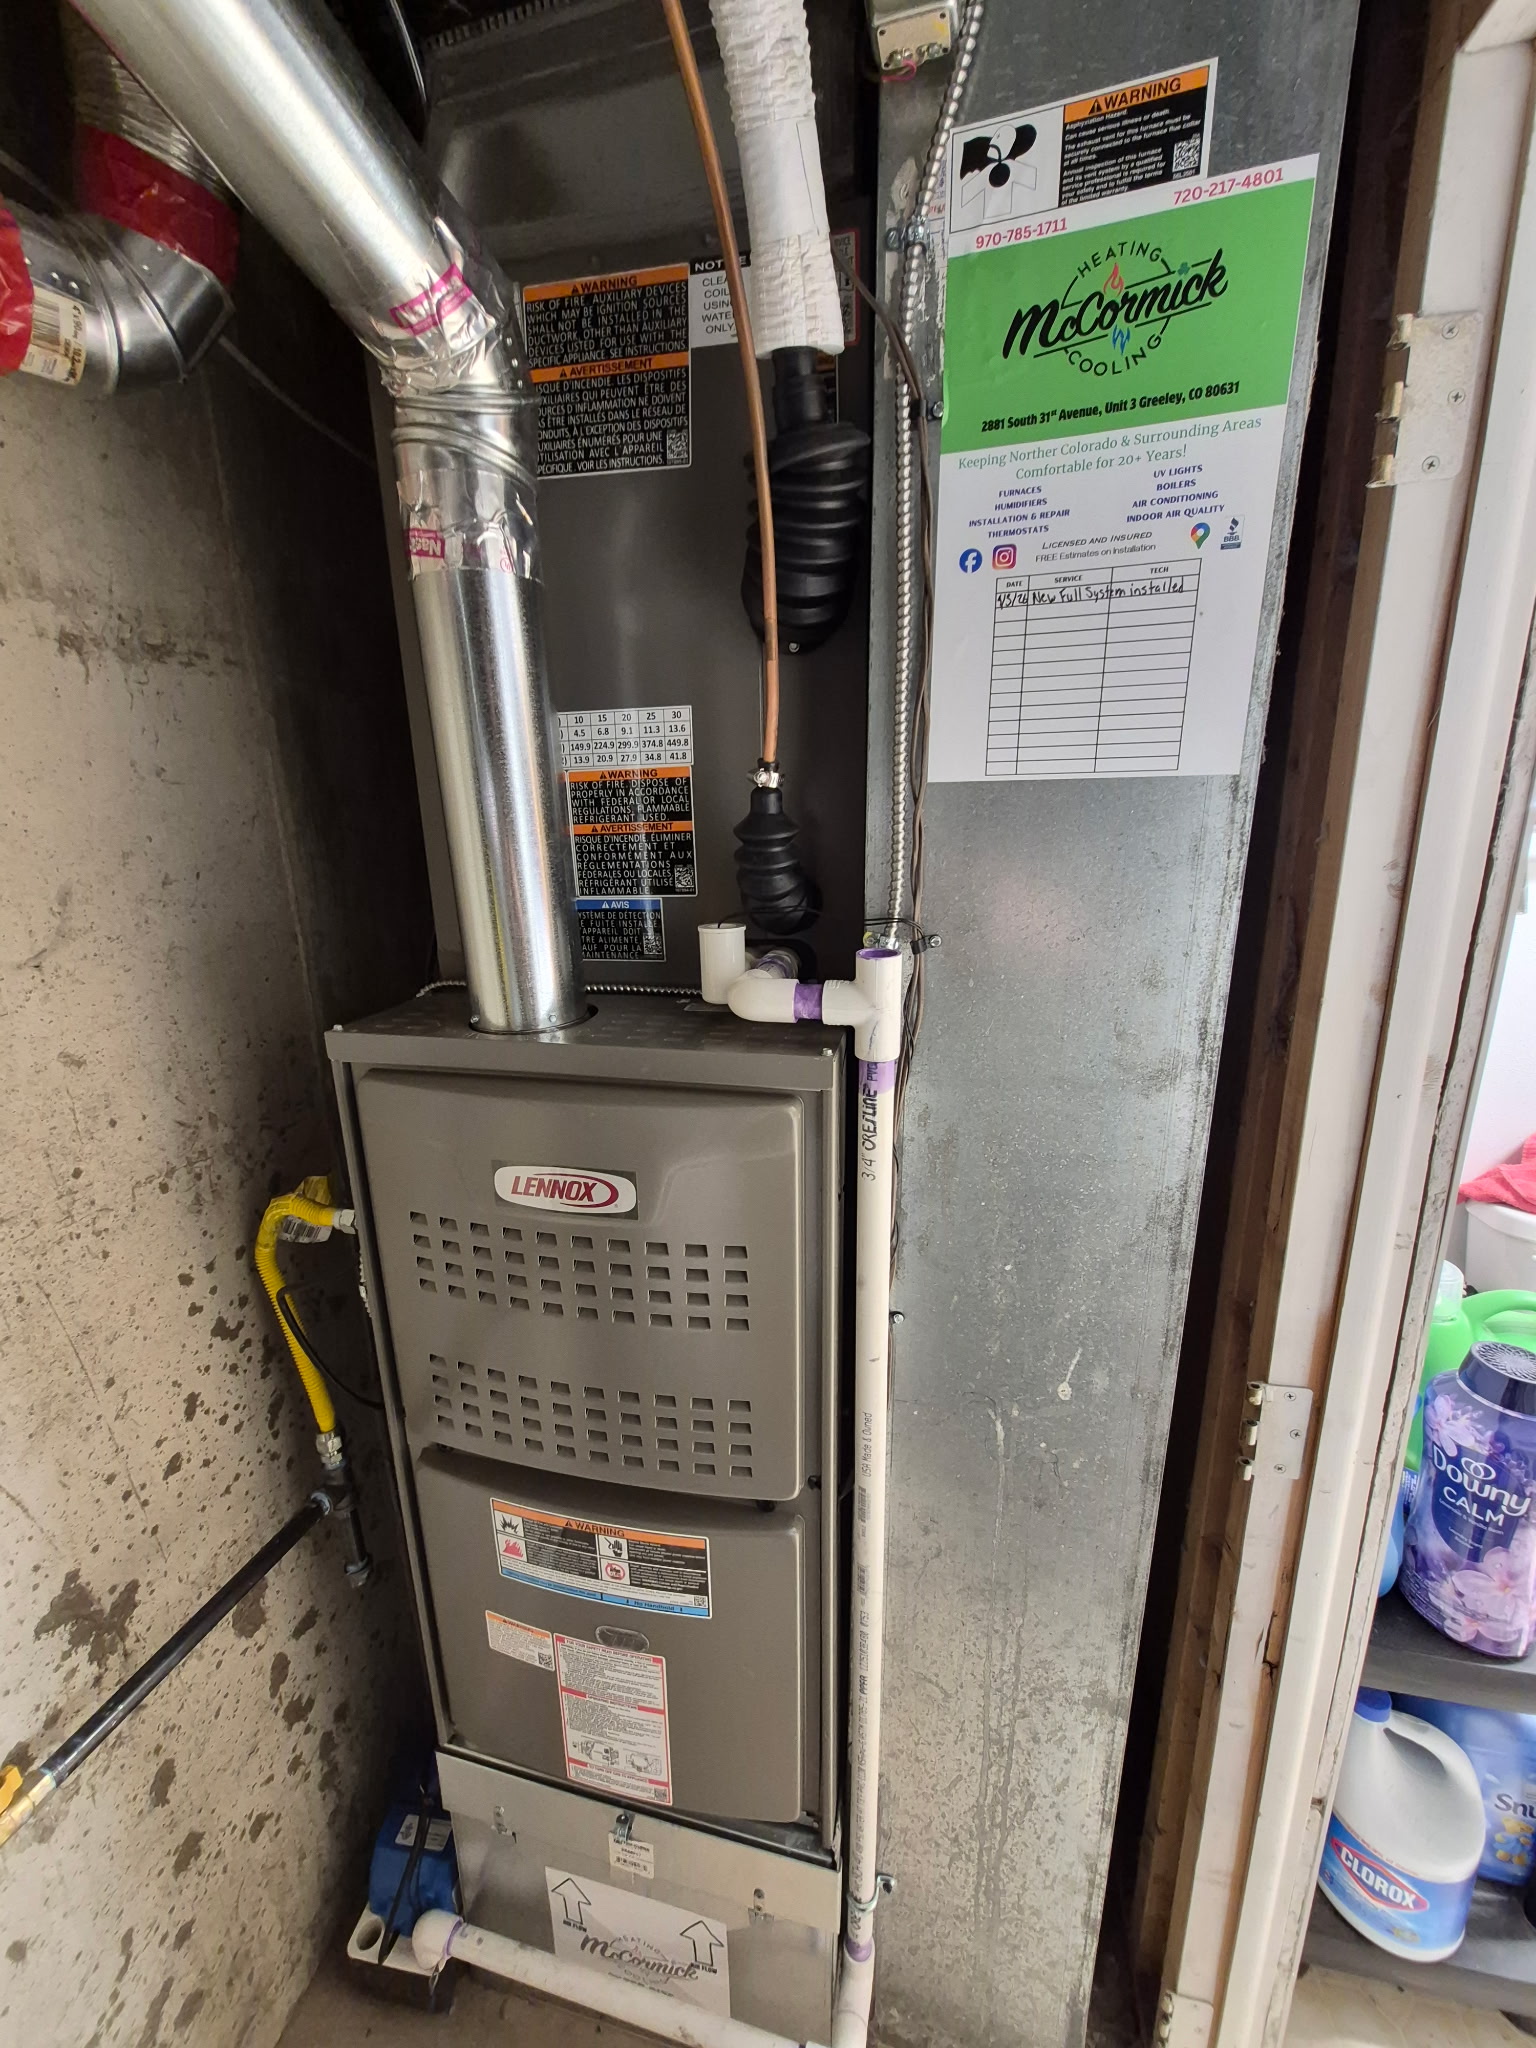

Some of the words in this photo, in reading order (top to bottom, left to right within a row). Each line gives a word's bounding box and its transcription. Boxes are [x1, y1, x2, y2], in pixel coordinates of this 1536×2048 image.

[1105, 78, 1181, 109] WARNING
[1174, 168, 1283, 205] 720-217-4801
[976, 218, 1067, 249] 970-785-1711
[1078, 241, 1162, 278] HEATING
[581, 276, 638, 293] WARNING
[527, 302, 545, 312] RISK
[549, 299, 560, 310] OF
[593, 288, 642, 304] AUXILIARY
[646, 282, 686, 298] DEVICES
[1002, 249, 1228, 359] McCormick
[527, 312, 556, 324] WHICH
[562, 309, 580, 319] MAY
[643, 294, 686, 309] SOURCES
[1068, 334, 1161, 376] COOLING
[570, 358, 653, 377] AVERTISSEMENT
[981, 418, 1005, 432] 2881
[1007, 414, 1037, 428] South
[1058, 405, 1102, 421] Avenue,
[1105, 400, 1128, 414] Unit
[1130, 399, 1136, 409] 3
[1139, 392, 1185, 409] Greeley,
[1189, 388, 1202, 400] CO
[1205, 381, 1240, 397] 80631
[959, 452, 1007, 470] Keeping
[1009, 446, 1057, 463] Norther
[1060, 439, 1118, 456] Colorado
[1121, 435, 1130, 447] &
[1134, 423, 1219, 445] Surrounding
[1222, 417, 1261, 432] Areas
[1016, 461, 1092, 480] Comfortable
[1096, 457, 1114, 469] for
[1119, 452, 1142, 466] 20+
[1147, 444, 1187, 462] Years!
[1154, 468, 1166, 479] UV
[1168, 465, 1203, 476] LIGHTS
[998, 486, 1041, 498] FURNACES
[1157, 479, 1196, 491] BOILERS
[994, 498, 1047, 511] HUMIDIFIERS
[1132, 499, 1147, 508] AIR
[1150, 491, 1218, 507] CONDITIONING
[969, 514, 1028, 527] INSTALLATION
[1040, 509, 1070, 519] REPAIR
[1126, 512, 1163, 523] INDOOR
[1166, 510, 1181, 520] AIR
[1184, 504, 1225, 518] QUALITY
[988, 525, 1049, 538] THERMOSTATS
[1090, 537, 1107, 545] AND
[1036, 553, 1057, 562] FREE
[1060, 549, 1099, 560] Estimates
[1054, 575, 1083, 583] SERVICE
[1150, 566, 1168, 574] TECH
[1033, 590, 1055, 605] New
[1059, 587, 1081, 603] Full
[1085, 584, 1126, 603] System
[1130, 576, 1184, 596] installed
[575, 716, 583, 724] 10
[598, 714, 607, 722] 15
[622, 713, 631, 721] 20
[647, 712, 656, 720] 25
[672, 711, 681, 719] 30
[574, 729, 585, 737] 4.5
[621, 727, 633, 735] 9.1
[644, 725, 660, 734] 11.3
[669, 724, 685, 732] 13.6
[571, 743, 591, 751] 149.9
[594, 741, 614, 749] 224.9
[618, 740, 638, 749] 299.9
[642, 740, 663, 748] 374.8
[667, 739, 689, 747] 449.8
[574, 756, 589, 764] 13.9
[597, 754, 613, 762] 20.9
[621, 754, 637, 762] 27.9
[645, 753, 661, 761] 34.8
[670, 752, 687, 760] 41.8
[608, 769, 657, 779] WARNING
[570, 782, 591, 790] RISK
[592, 781, 602, 789] OF
[631, 778, 668, 788] DISPOSE
[675, 777, 687, 786] OF
[571, 790, 612, 798] PROPERLY
[629, 786, 688, 796] ACCORDANCE
[572, 799, 595, 807] WITH
[601, 797, 640, 806] FEDERAL
[643, 796, 655, 804] OR
[661, 795, 689, 803] LOCAL
[637, 804, 690, 813] FLAMMABLE
[574, 814, 635, 824] REFRIGERANT
[601, 822, 673, 832] AVERTISSEMENT
[575, 835, 601, 843] RISQUE
[576, 843, 657, 852] CORRECTEMENT
[663, 842, 675, 850] ET
[670, 851, 692, 859] AUX
[623, 869, 635, 878] OU
[511, 1176, 597, 1202] LENNOX
[1433, 1444, 1531, 1517] Downy
[1443, 1486, 1504, 1526] CALM
[575, 1520, 625, 1538] WARNING
[1341, 1846, 1416, 1910] CLOROX
[581, 1934, 699, 1980] McCormick
